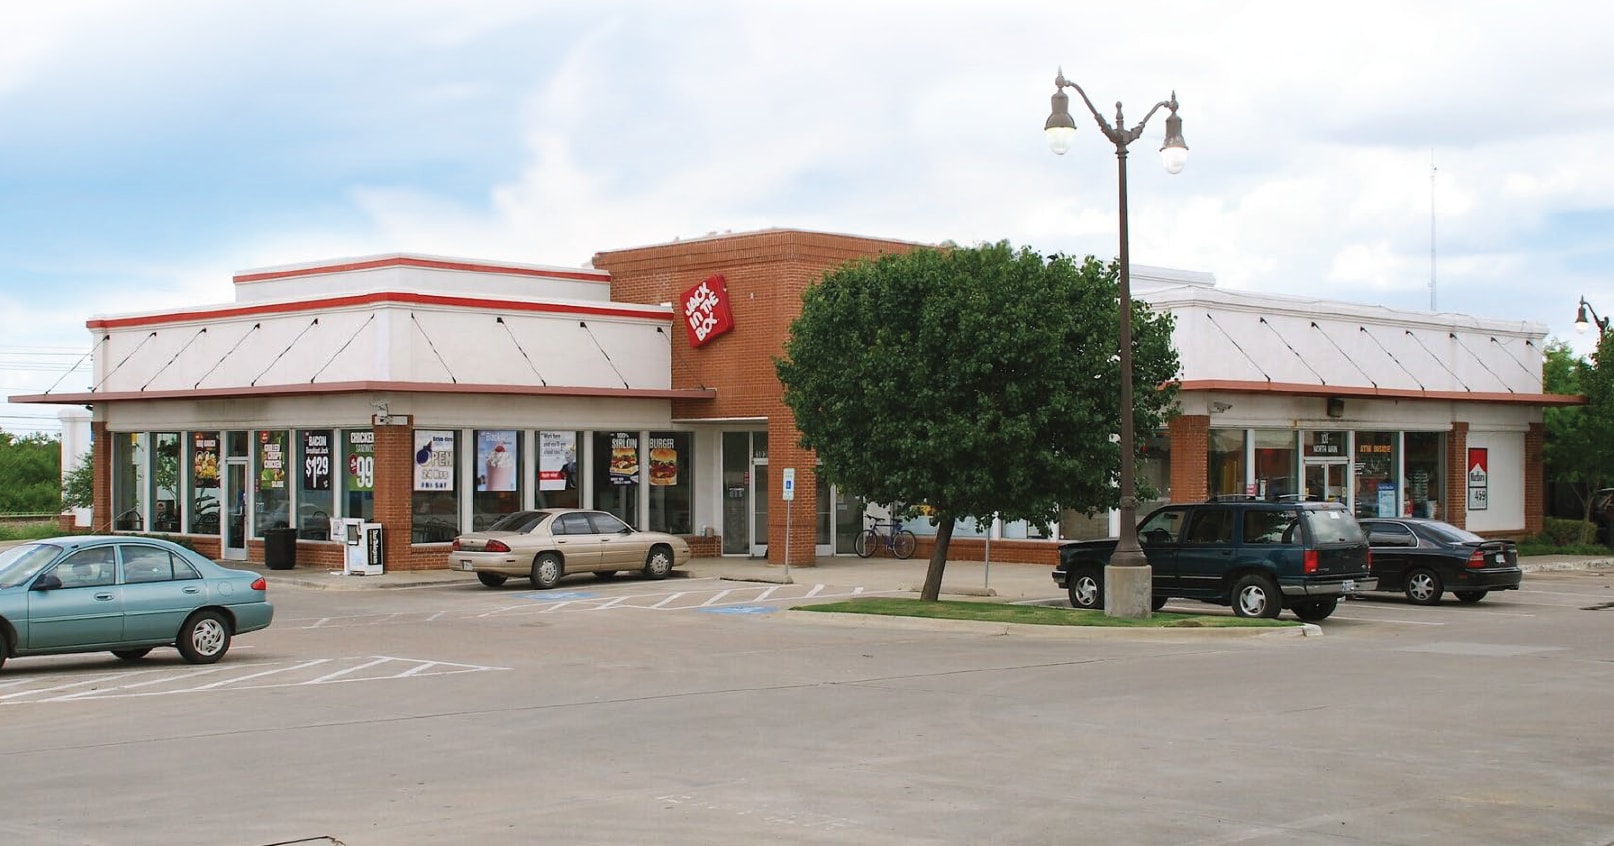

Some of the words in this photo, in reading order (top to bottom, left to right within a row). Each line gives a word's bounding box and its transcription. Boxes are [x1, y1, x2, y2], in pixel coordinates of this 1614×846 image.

[685, 282, 710, 316] JACK
[700, 291, 719, 314] THE
[695, 312, 718, 342] BOX
[309, 435, 326, 446] BACON
[612, 438, 637, 448] SIRLOIN
[650, 438, 675, 448] BURGER
[356, 444, 374, 452] SANDWIC
[1313, 445, 1327, 453] NORTH
[1360, 445, 1372, 453] ATM
[1373, 445, 1391, 453] INSIDE
